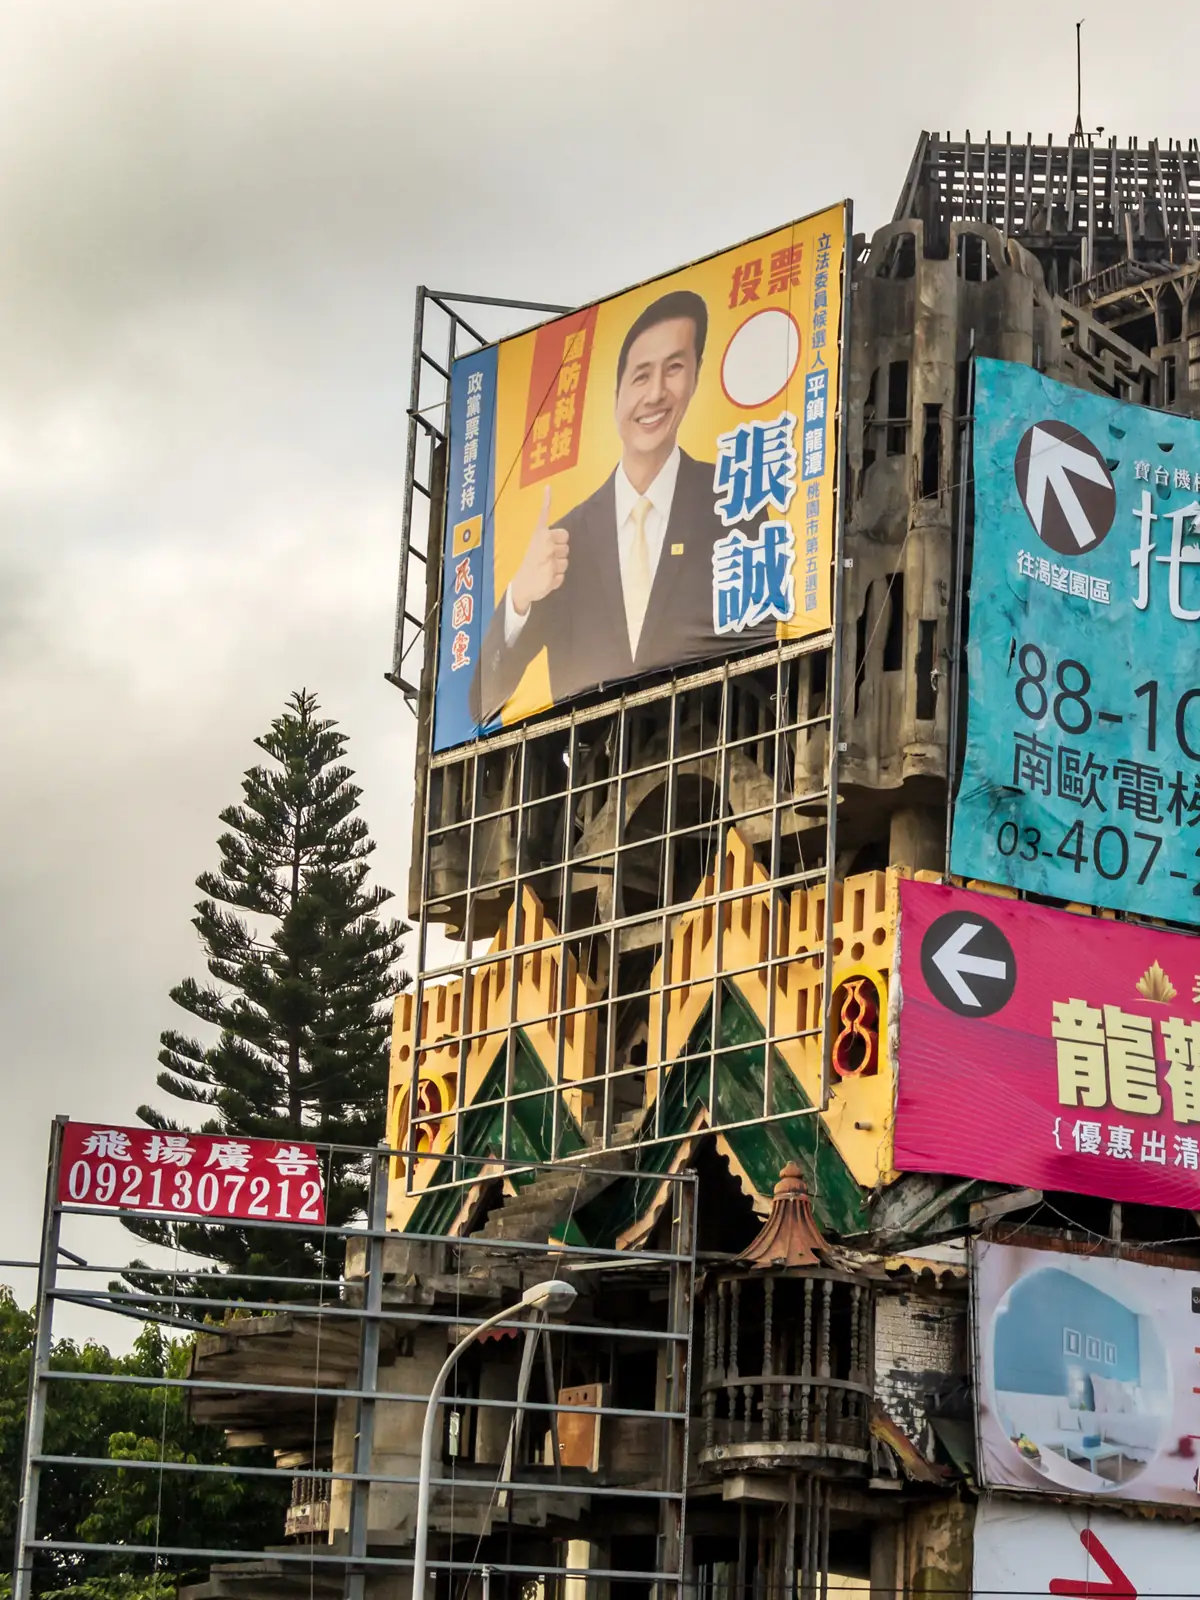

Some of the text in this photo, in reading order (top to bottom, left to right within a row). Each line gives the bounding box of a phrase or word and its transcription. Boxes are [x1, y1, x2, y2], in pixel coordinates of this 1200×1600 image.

[728, 242, 803, 309] 投票
[811, 232, 832, 369] 立法委員候選人
[460, 371, 484, 512] 政黨票請支持
[804, 374, 827, 475] 平鎮 龍潭
[714, 412, 799, 635] 張誠
[804, 482, 821, 612] 桃園市第五選區
[1016, 549, 1111, 604] 往渴望園區
[68, 1160, 321, 1221] 0921307212
[80, 1130, 318, 1176] 飛揚廣告
